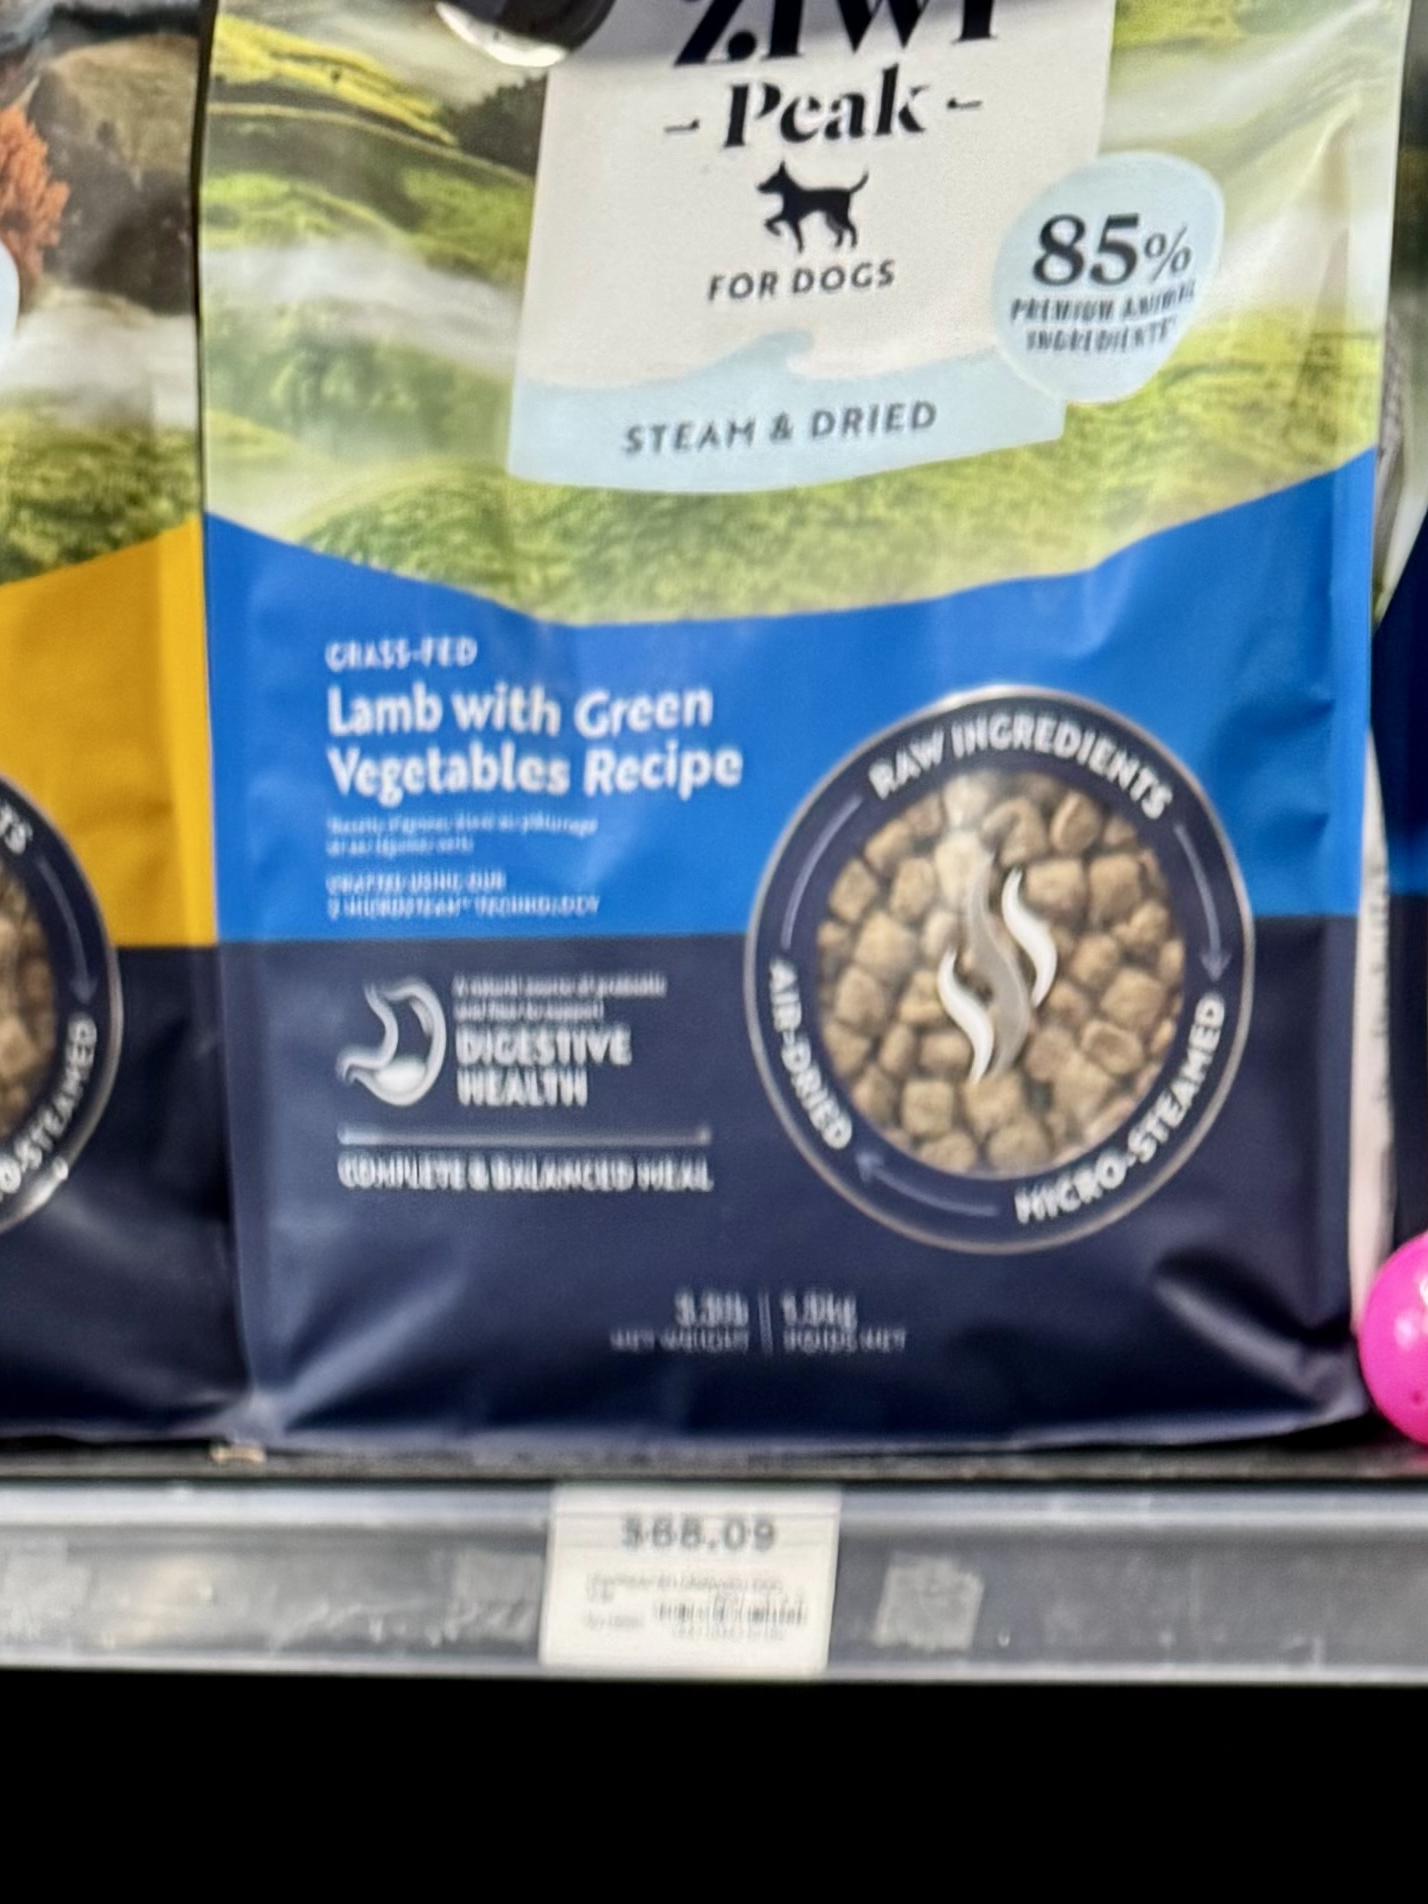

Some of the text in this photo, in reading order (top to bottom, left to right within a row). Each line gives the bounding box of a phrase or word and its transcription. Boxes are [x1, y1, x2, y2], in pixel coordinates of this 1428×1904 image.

[723, 63, 927, 150] Peak
[1032, 212, 1192, 287] 85%
[708, 258, 896, 301] FOR DOGS
[624, 400, 940, 457] STEAM & DRIED
[326, 637, 478, 671] GRASS-FED
[327, 680, 713, 739] Lamb with Green
[327, 739, 743, 808] Vegetables Recipe
[870, 715, 1172, 820] RAW INGREDIENTS
[455, 1024, 633, 1066] DIGESTIVE
[770, 957, 854, 1151] AIR-DRIED
[457, 1067, 588, 1107] HEALTH
[1015, 993, 1226, 1226] MICRO-STEAMED
[337, 1155, 466, 1190] COMPLETE
[637, 1154, 714, 1192] MEAL
